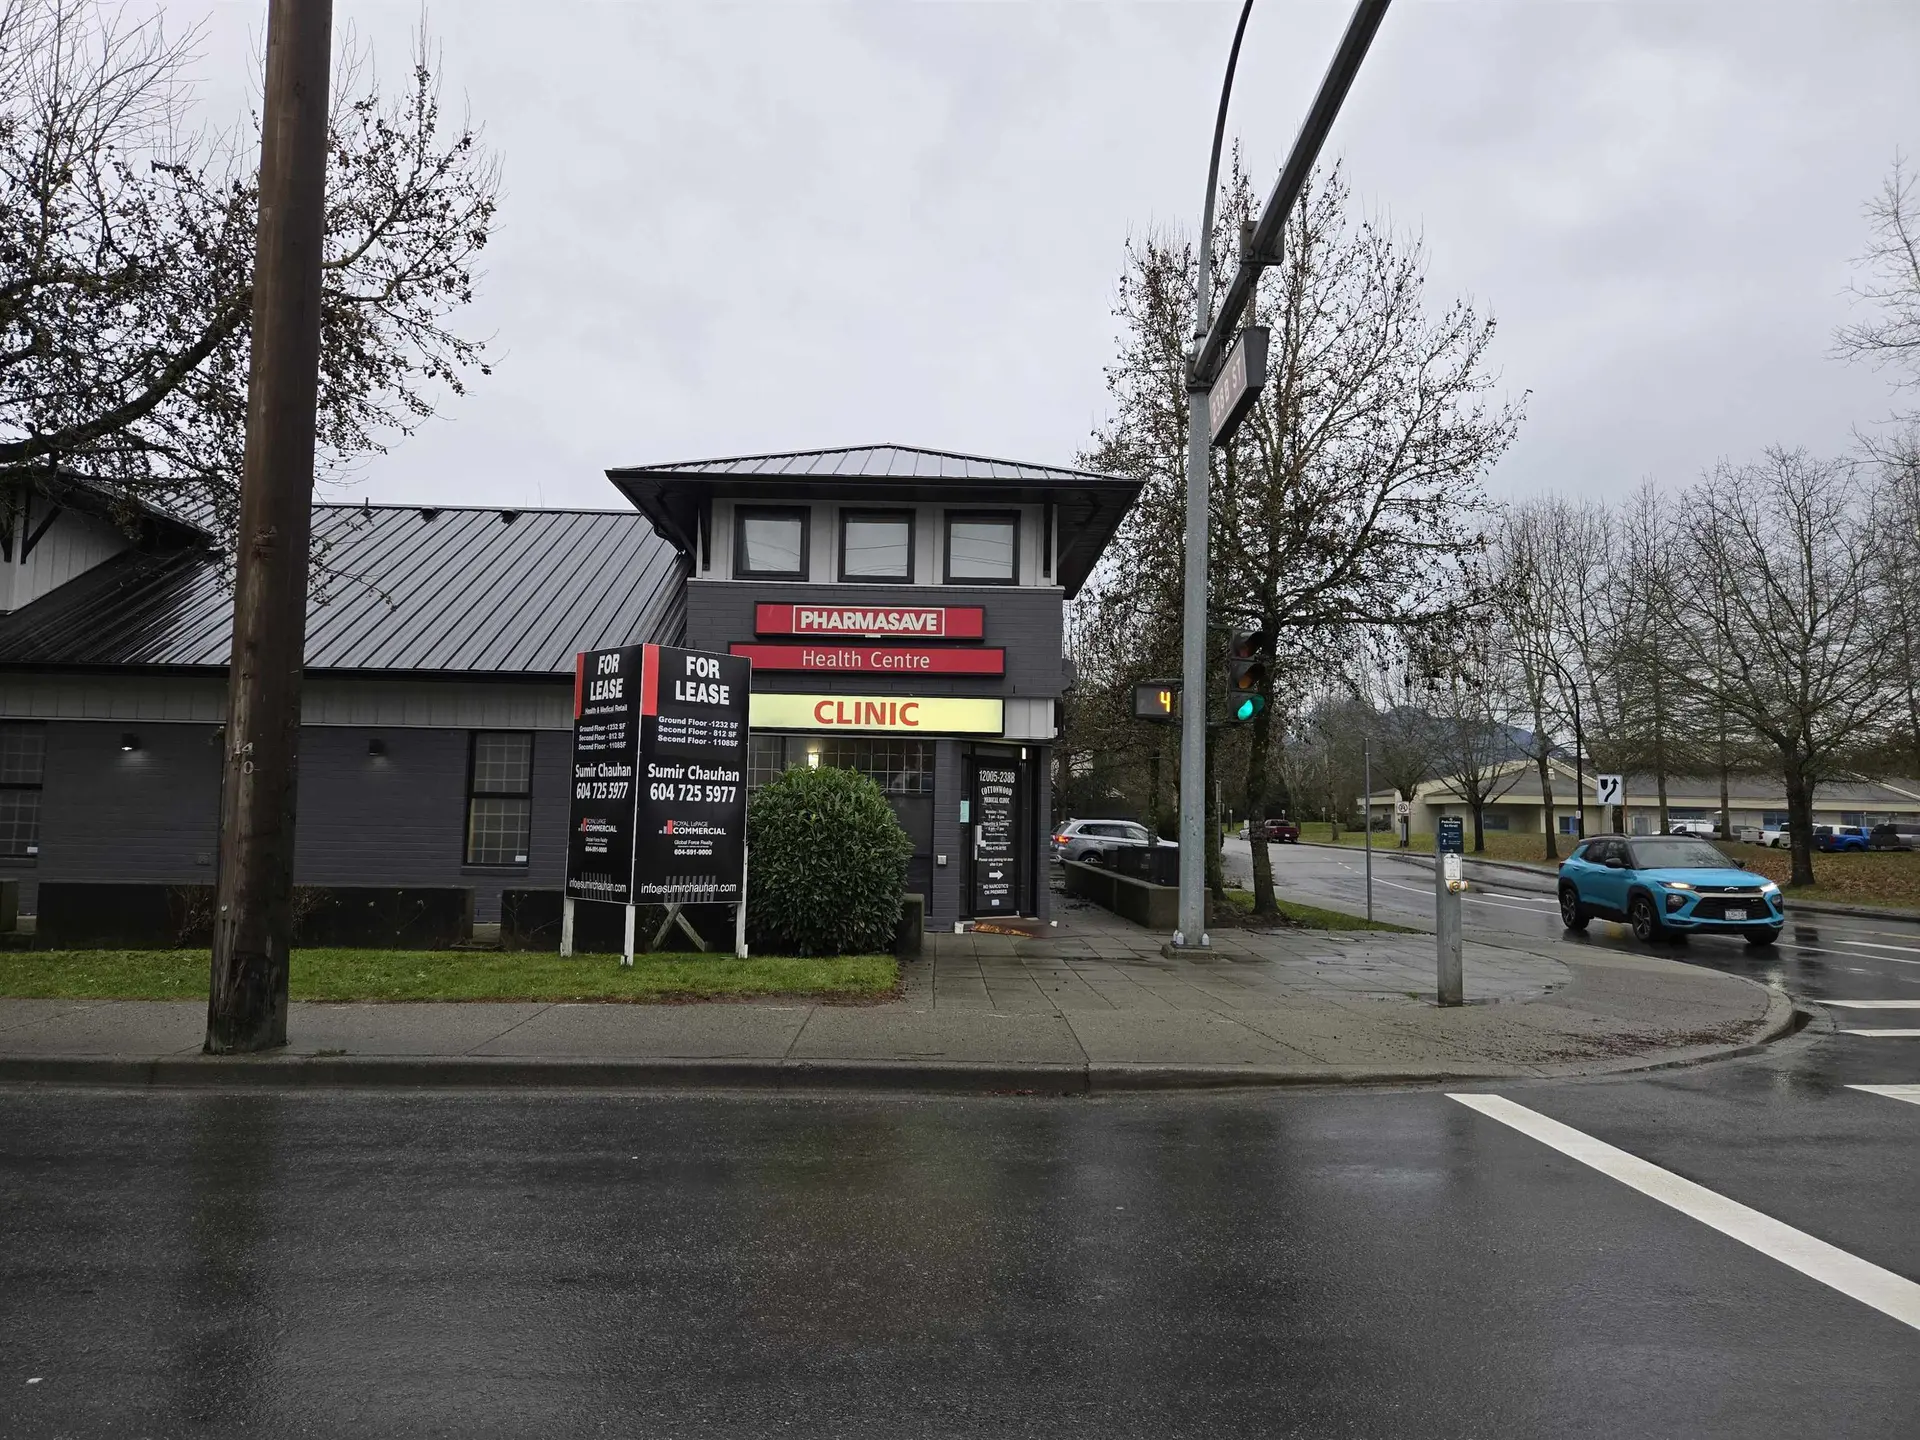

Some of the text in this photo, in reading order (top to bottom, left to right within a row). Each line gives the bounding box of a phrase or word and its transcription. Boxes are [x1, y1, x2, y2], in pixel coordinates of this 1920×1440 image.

[1232, 356, 1241, 389] ST
[800, 611, 937, 631] PHARMASAVE
[598, 654, 619, 675] FOR
[686, 656, 720, 679] FOR
[803, 651, 930, 668] Health Centre
[590, 678, 623, 701] LEASE
[675, 681, 730, 705] LEASE
[1160, 691, 1171, 712] 4
[814, 700, 919, 726] CLINIC
[659, 716, 687, 725] Ground
[688, 718, 707, 726] Floor
[709, 719, 728, 728] -1232
[658, 725, 687, 735] Second
[688, 727, 708, 736] Floor
[714, 729, 727, 737] 812
[658, 735, 686, 744] Second
[688, 736, 706, 745] Floor
[576, 763, 631, 778] Sumir Chauhan
[648, 764, 740, 782] Sumir Chauhan
[576, 782, 628, 799] 604 725 5977
[650, 783, 736, 803] 604 725 5977
[981, 785, 1012, 796] COTTONWOOD
[999, 797, 1010, 805] CLINIC
[673, 827, 726, 835] COMMERCIAL
[569, 877, 626, 893] info@sumirchauhan.com
[641, 882, 736, 895] info@sumirchauhan.com
